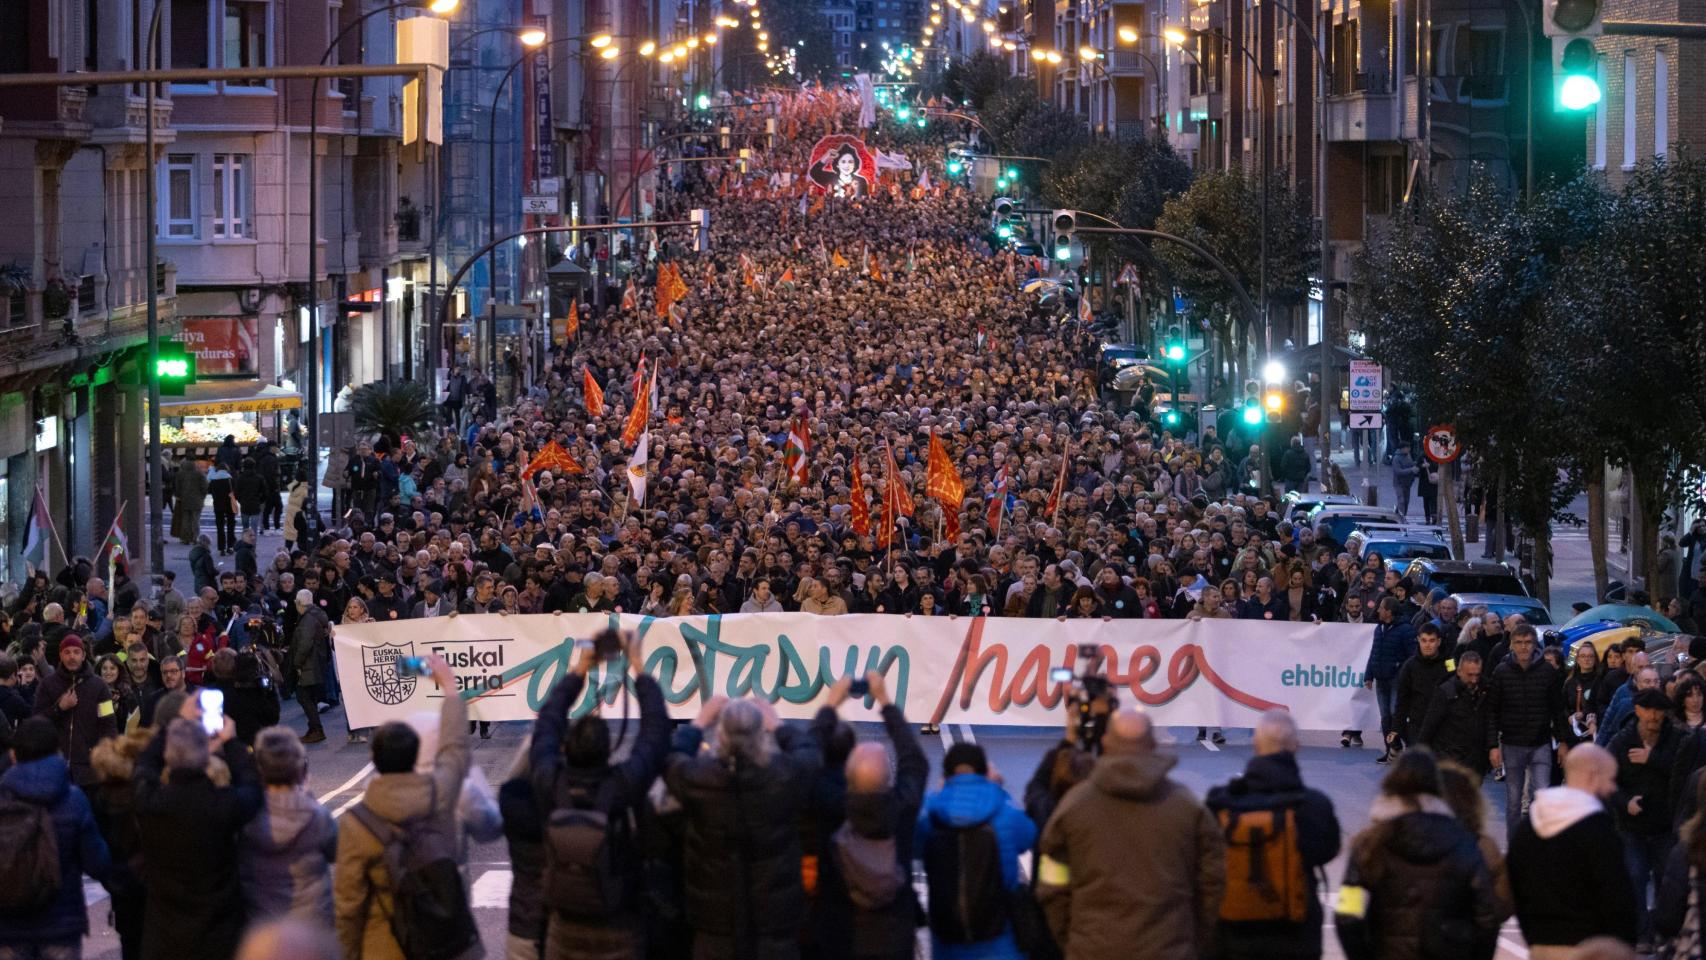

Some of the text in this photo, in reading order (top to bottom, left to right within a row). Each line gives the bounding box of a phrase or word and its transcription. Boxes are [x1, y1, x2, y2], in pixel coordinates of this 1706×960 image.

[187, 346, 236, 359] rduras
[373, 648, 404, 657] EUSKAL
[374, 655, 402, 664] HERRI
[434, 669, 504, 691] erria
[1281, 663, 1364, 688] ehbildu
